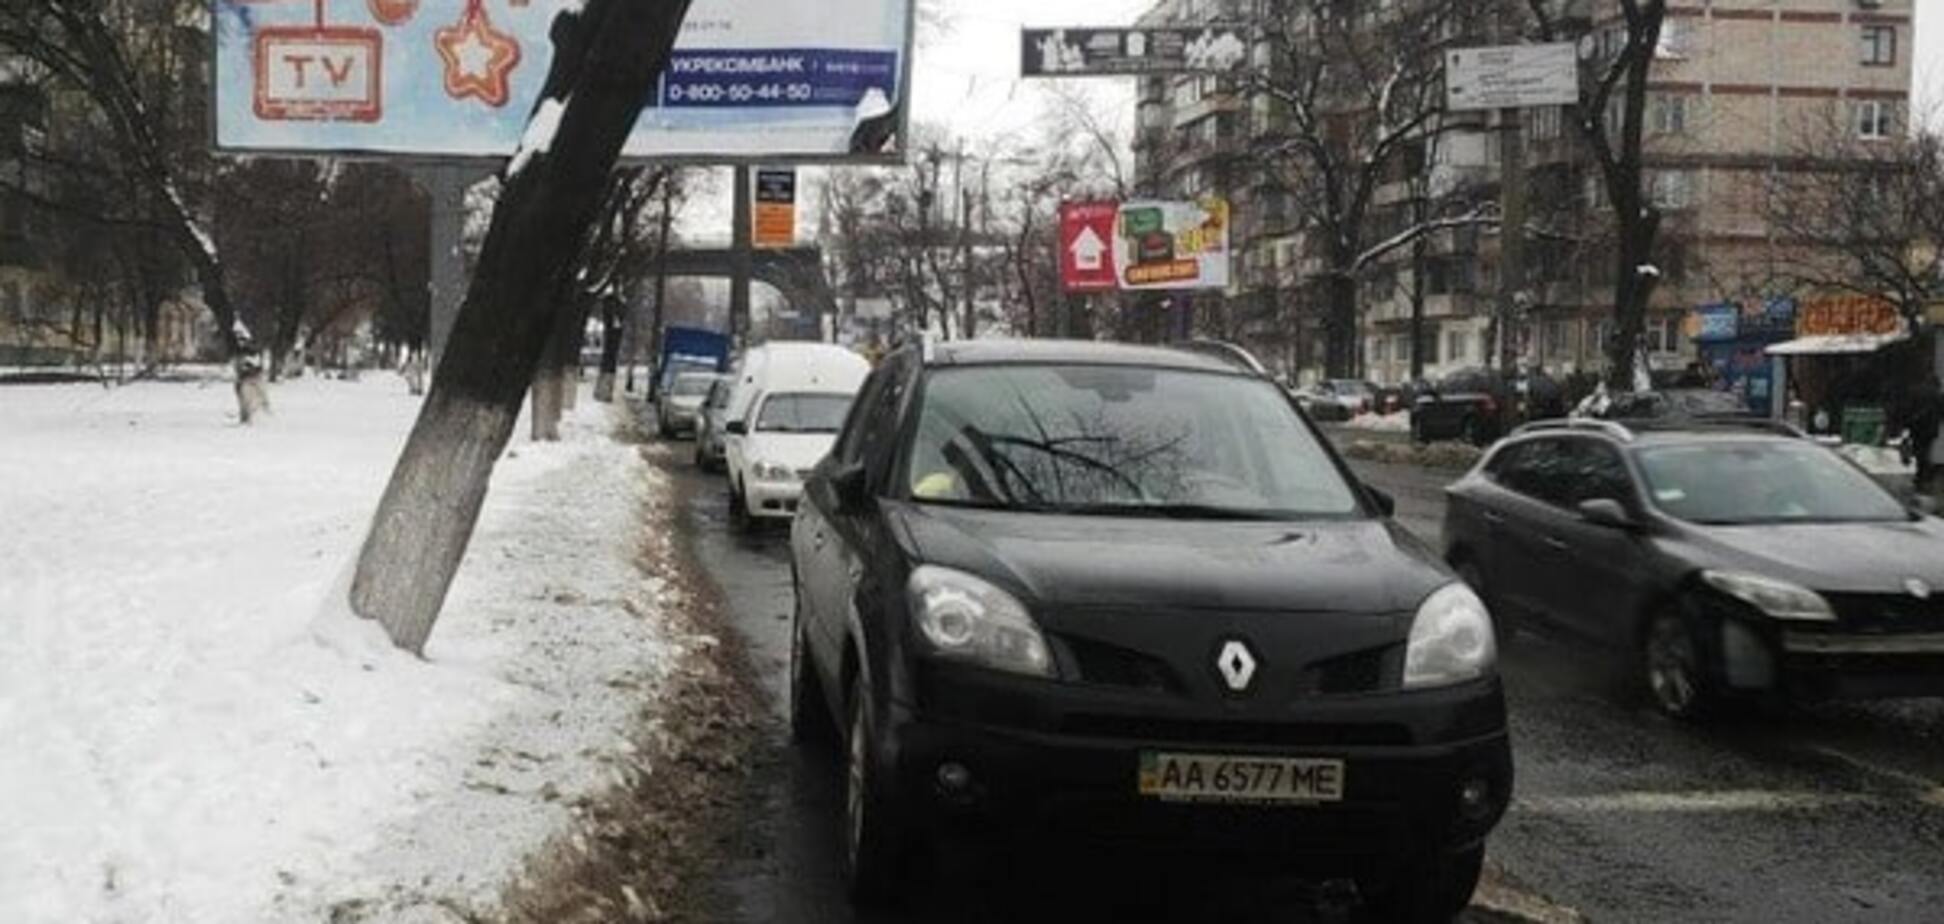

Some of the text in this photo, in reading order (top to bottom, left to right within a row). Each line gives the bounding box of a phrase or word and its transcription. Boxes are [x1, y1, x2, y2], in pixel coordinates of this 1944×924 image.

[283, 54, 355, 89] TV
[669, 83, 811, 101] 0-800-50-44-50
[1161, 758, 1337, 795] AA 6577 ME
